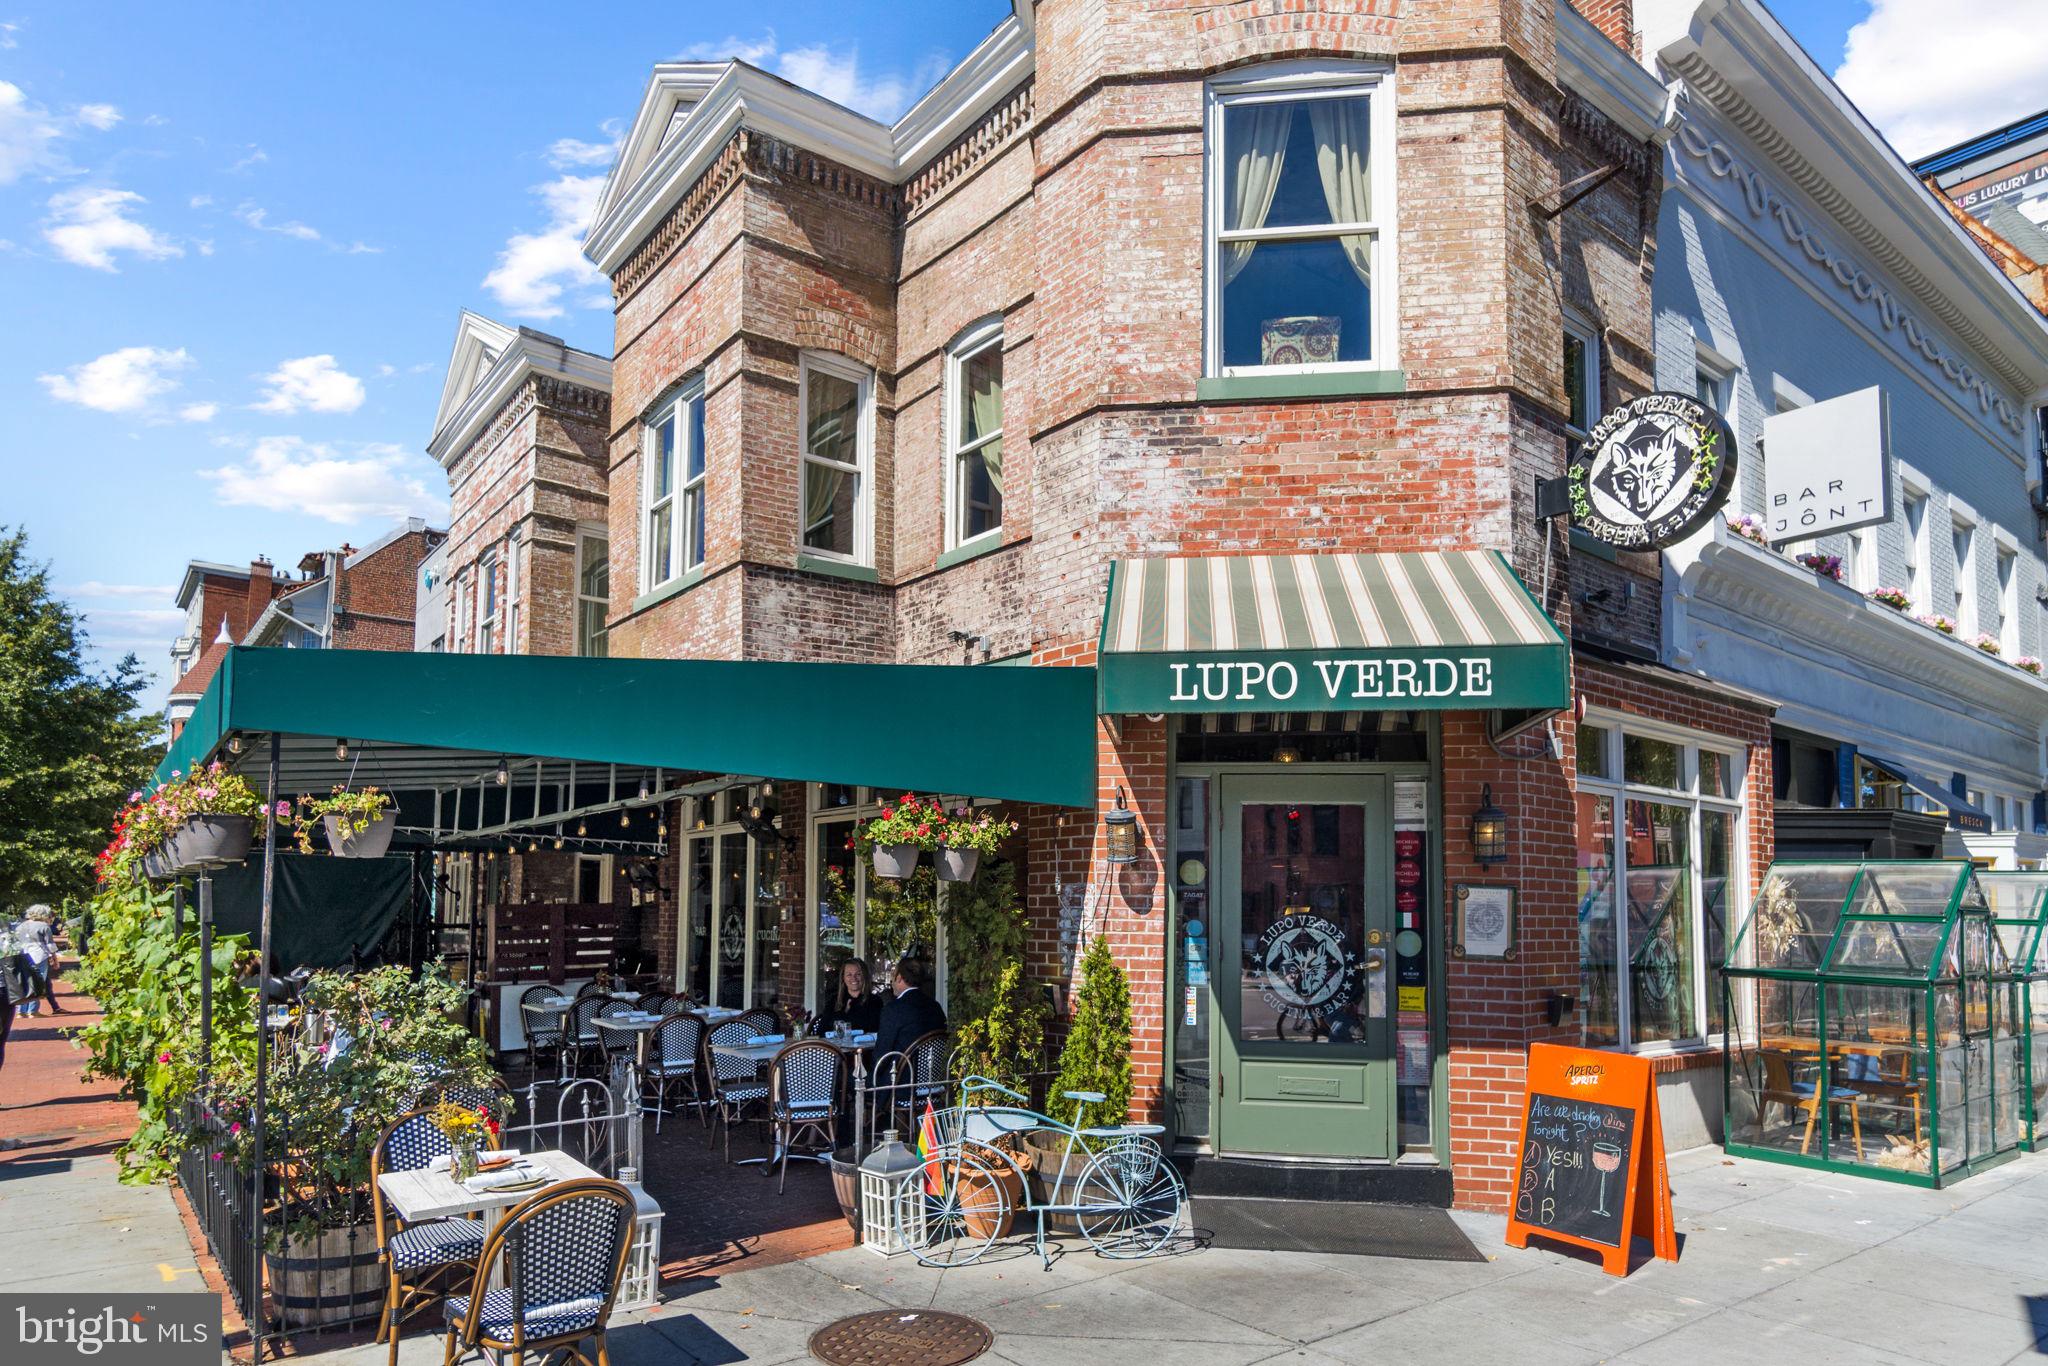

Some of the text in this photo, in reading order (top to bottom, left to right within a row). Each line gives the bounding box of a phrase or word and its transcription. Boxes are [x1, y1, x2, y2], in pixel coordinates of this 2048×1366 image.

[1980, 173, 2029, 201] LUXURY
[1582, 395, 1705, 451] LUPO VERDE
[1773, 479, 1843, 507] BAR
[1775, 498, 1874, 532] JÔNT
[1169, 657, 1493, 701] LUPO VERDE
[1260, 914, 1346, 947] LUPO VERDE
[1263, 991, 1350, 1020] CUCINA & BAR
[1564, 1065, 1606, 1078] APEROL
[1570, 1075, 1599, 1086] SPRITZ
[1530, 1096, 1551, 1118] Are
[1553, 1104, 1571, 1118] we
[1531, 1121, 1570, 1142] Tonight
[1546, 1145, 1584, 1169] YES!!!
[1543, 1167, 1555, 1192] A
[1541, 1197, 1555, 1225] B
